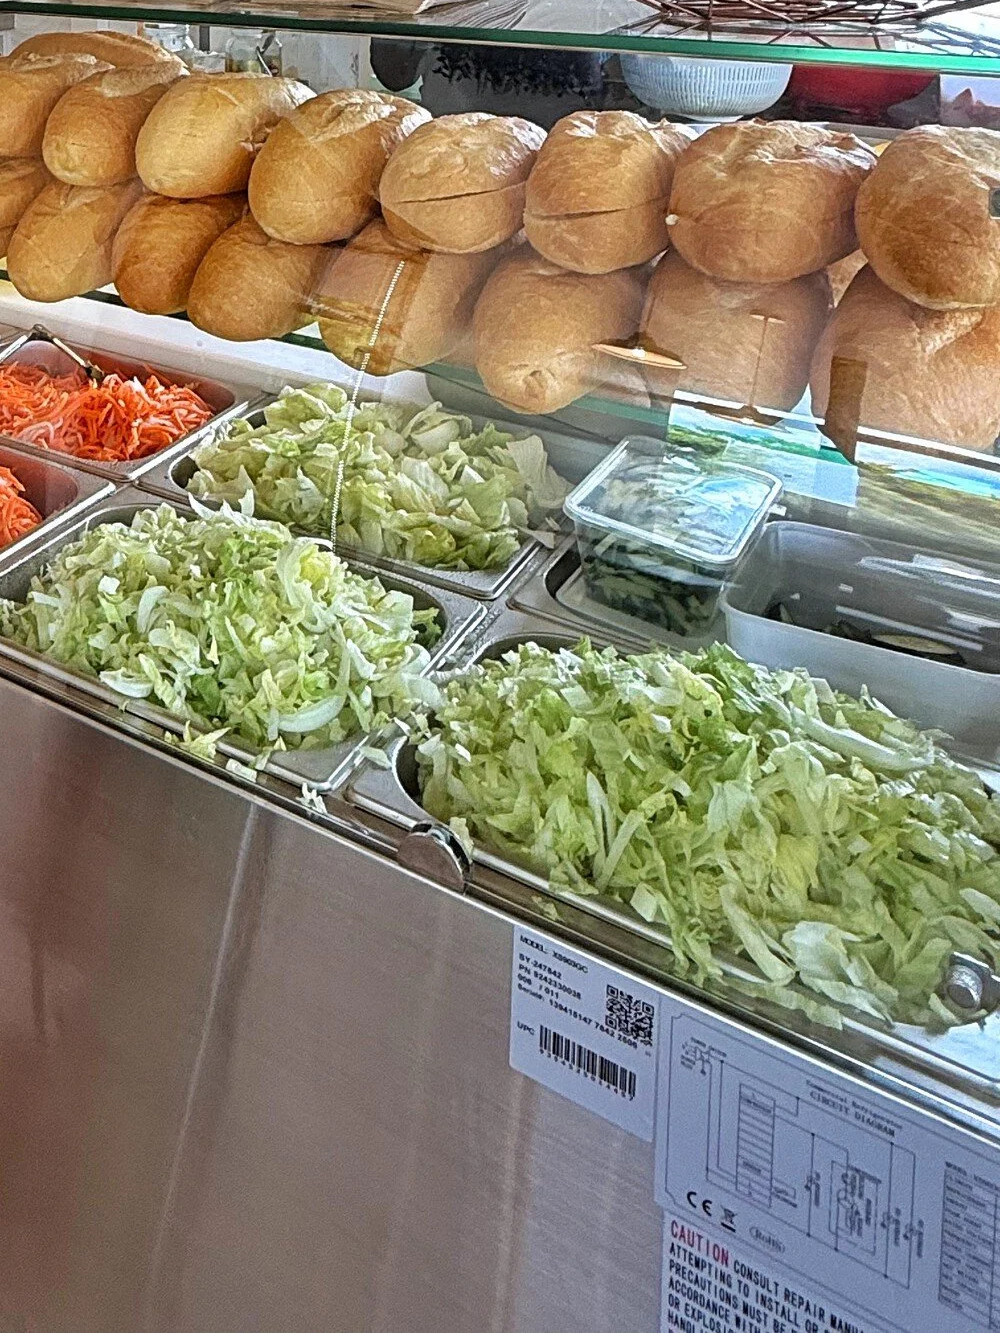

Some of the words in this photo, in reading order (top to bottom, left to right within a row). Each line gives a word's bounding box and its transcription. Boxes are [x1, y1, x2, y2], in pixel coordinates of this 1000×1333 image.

[517, 1021, 535, 1036] UPC
[669, 1275, 729, 1323] ACCORDANCE
[670, 1242, 732, 1288] ATTEMPTING
[738, 1279, 749, 1298] TO
[756, 1290, 800, 1328] INSTALL
[670, 1259, 738, 1309] PRECAUTIONS
[743, 1300, 768, 1326] MUST
[773, 1318, 786, 1333] BE
[671, 1219, 728, 1267] CAUTION
[734, 1260, 779, 1297] CONSULT
[784, 1287, 825, 1323] REPAIR
[668, 1293, 680, 1311] OR
